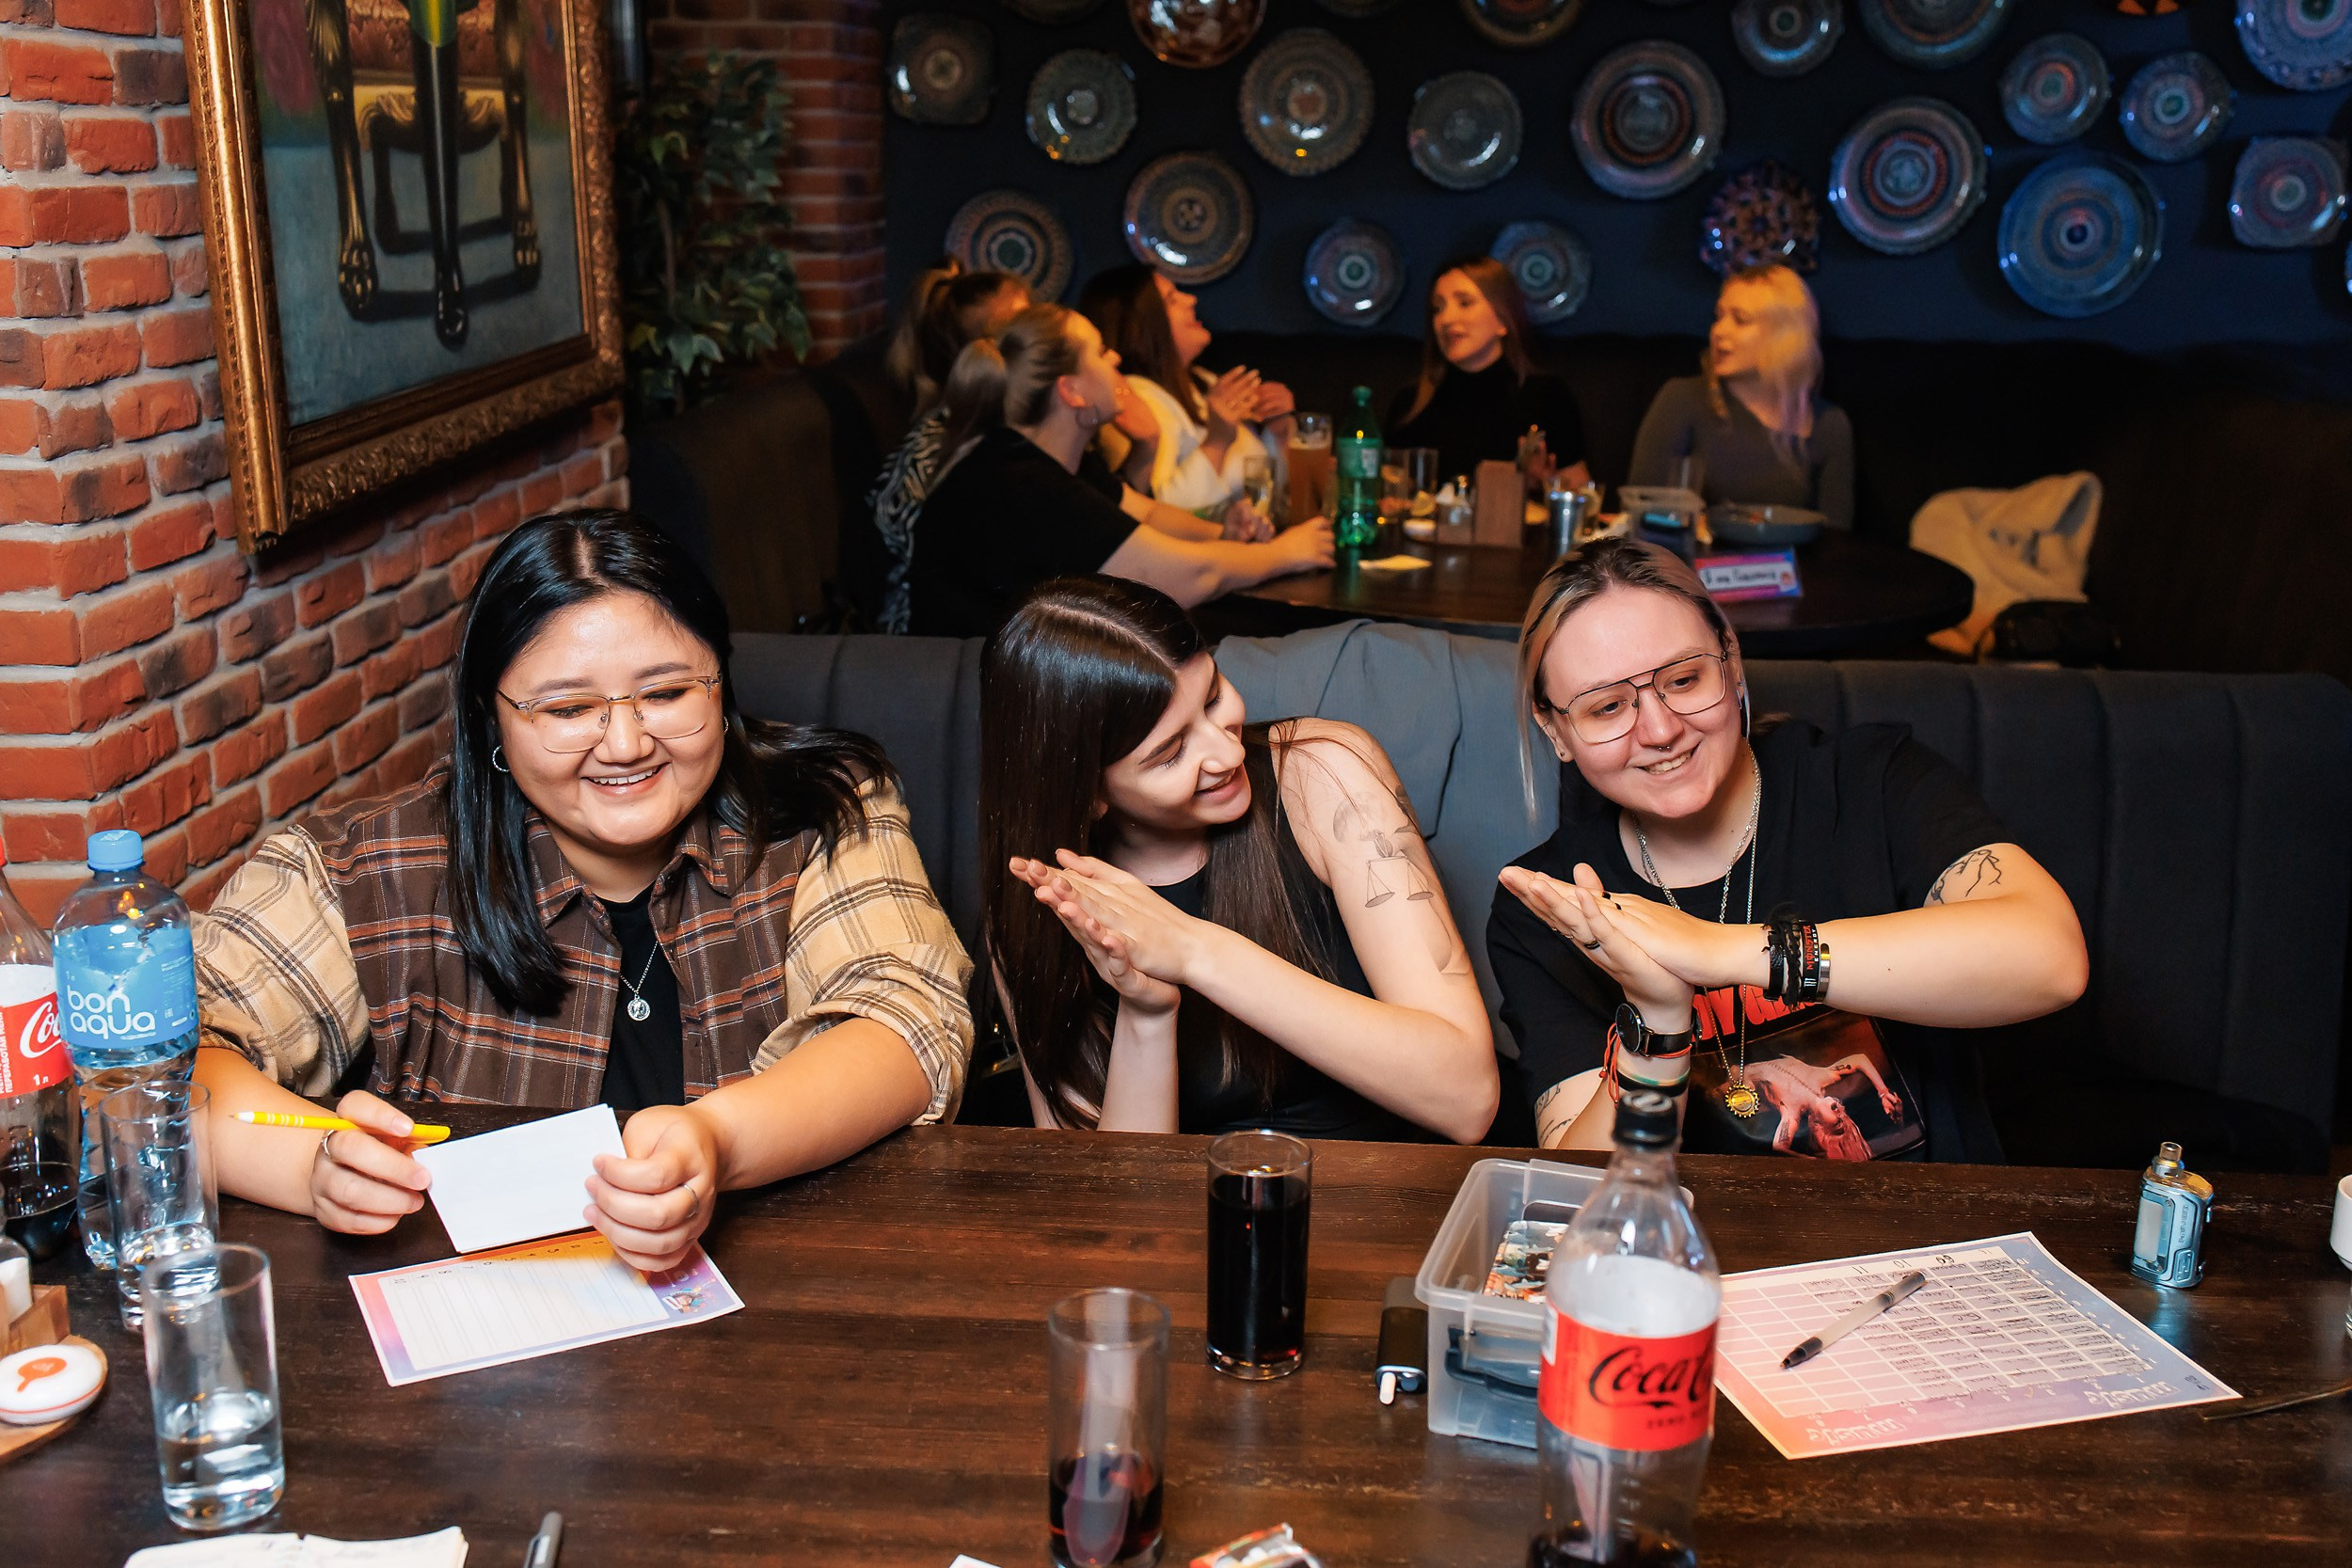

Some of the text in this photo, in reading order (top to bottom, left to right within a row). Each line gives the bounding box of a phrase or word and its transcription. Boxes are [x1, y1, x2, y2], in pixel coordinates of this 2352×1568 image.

[1804, 925, 1815, 970] MONSTER
[67, 985, 131, 1013] bon
[70, 1011, 156, 1040] aqua
[33, 1074, 40, 1085] 1
[1851, 1265, 1869, 1275] 11
[1589, 1345, 1690, 1408] Coca
[2083, 1381, 2182, 1408] music
[1806, 1418, 1907, 1446] music
